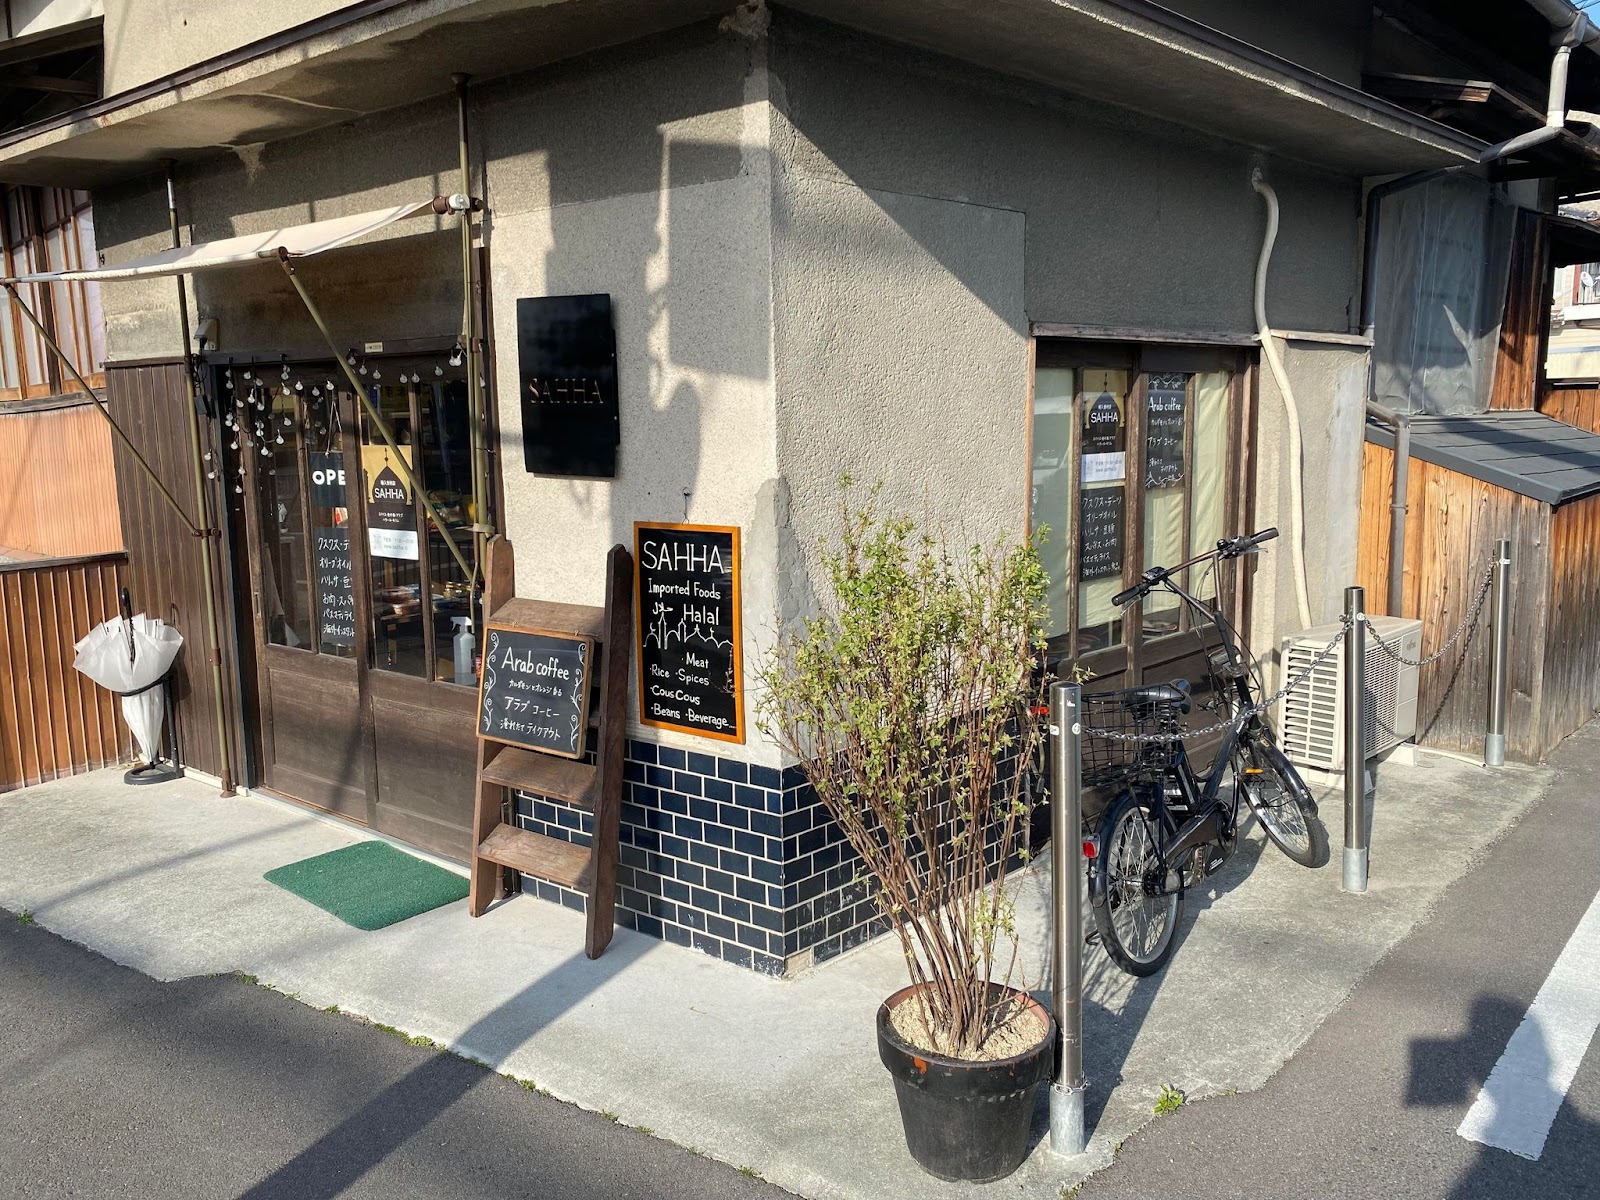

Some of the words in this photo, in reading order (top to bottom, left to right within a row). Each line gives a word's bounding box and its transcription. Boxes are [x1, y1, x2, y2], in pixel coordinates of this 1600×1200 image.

[529, 378, 604, 404] SAHHA
[1091, 412, 1118, 423] SAHHA
[374, 487, 405, 500] SAHHA
[642, 541, 724, 574] SAHHA
[648, 578, 690, 597] Imported
[693, 581, 721, 600] Foods
[652, 602, 674, 615] حلال
[683, 604, 719, 625] Halal
[501, 646, 534, 674] Arab
[536, 656, 570, 680] coffee
[504, 696, 531, 713] アラブ
[532, 705, 560, 718] コーヒー
